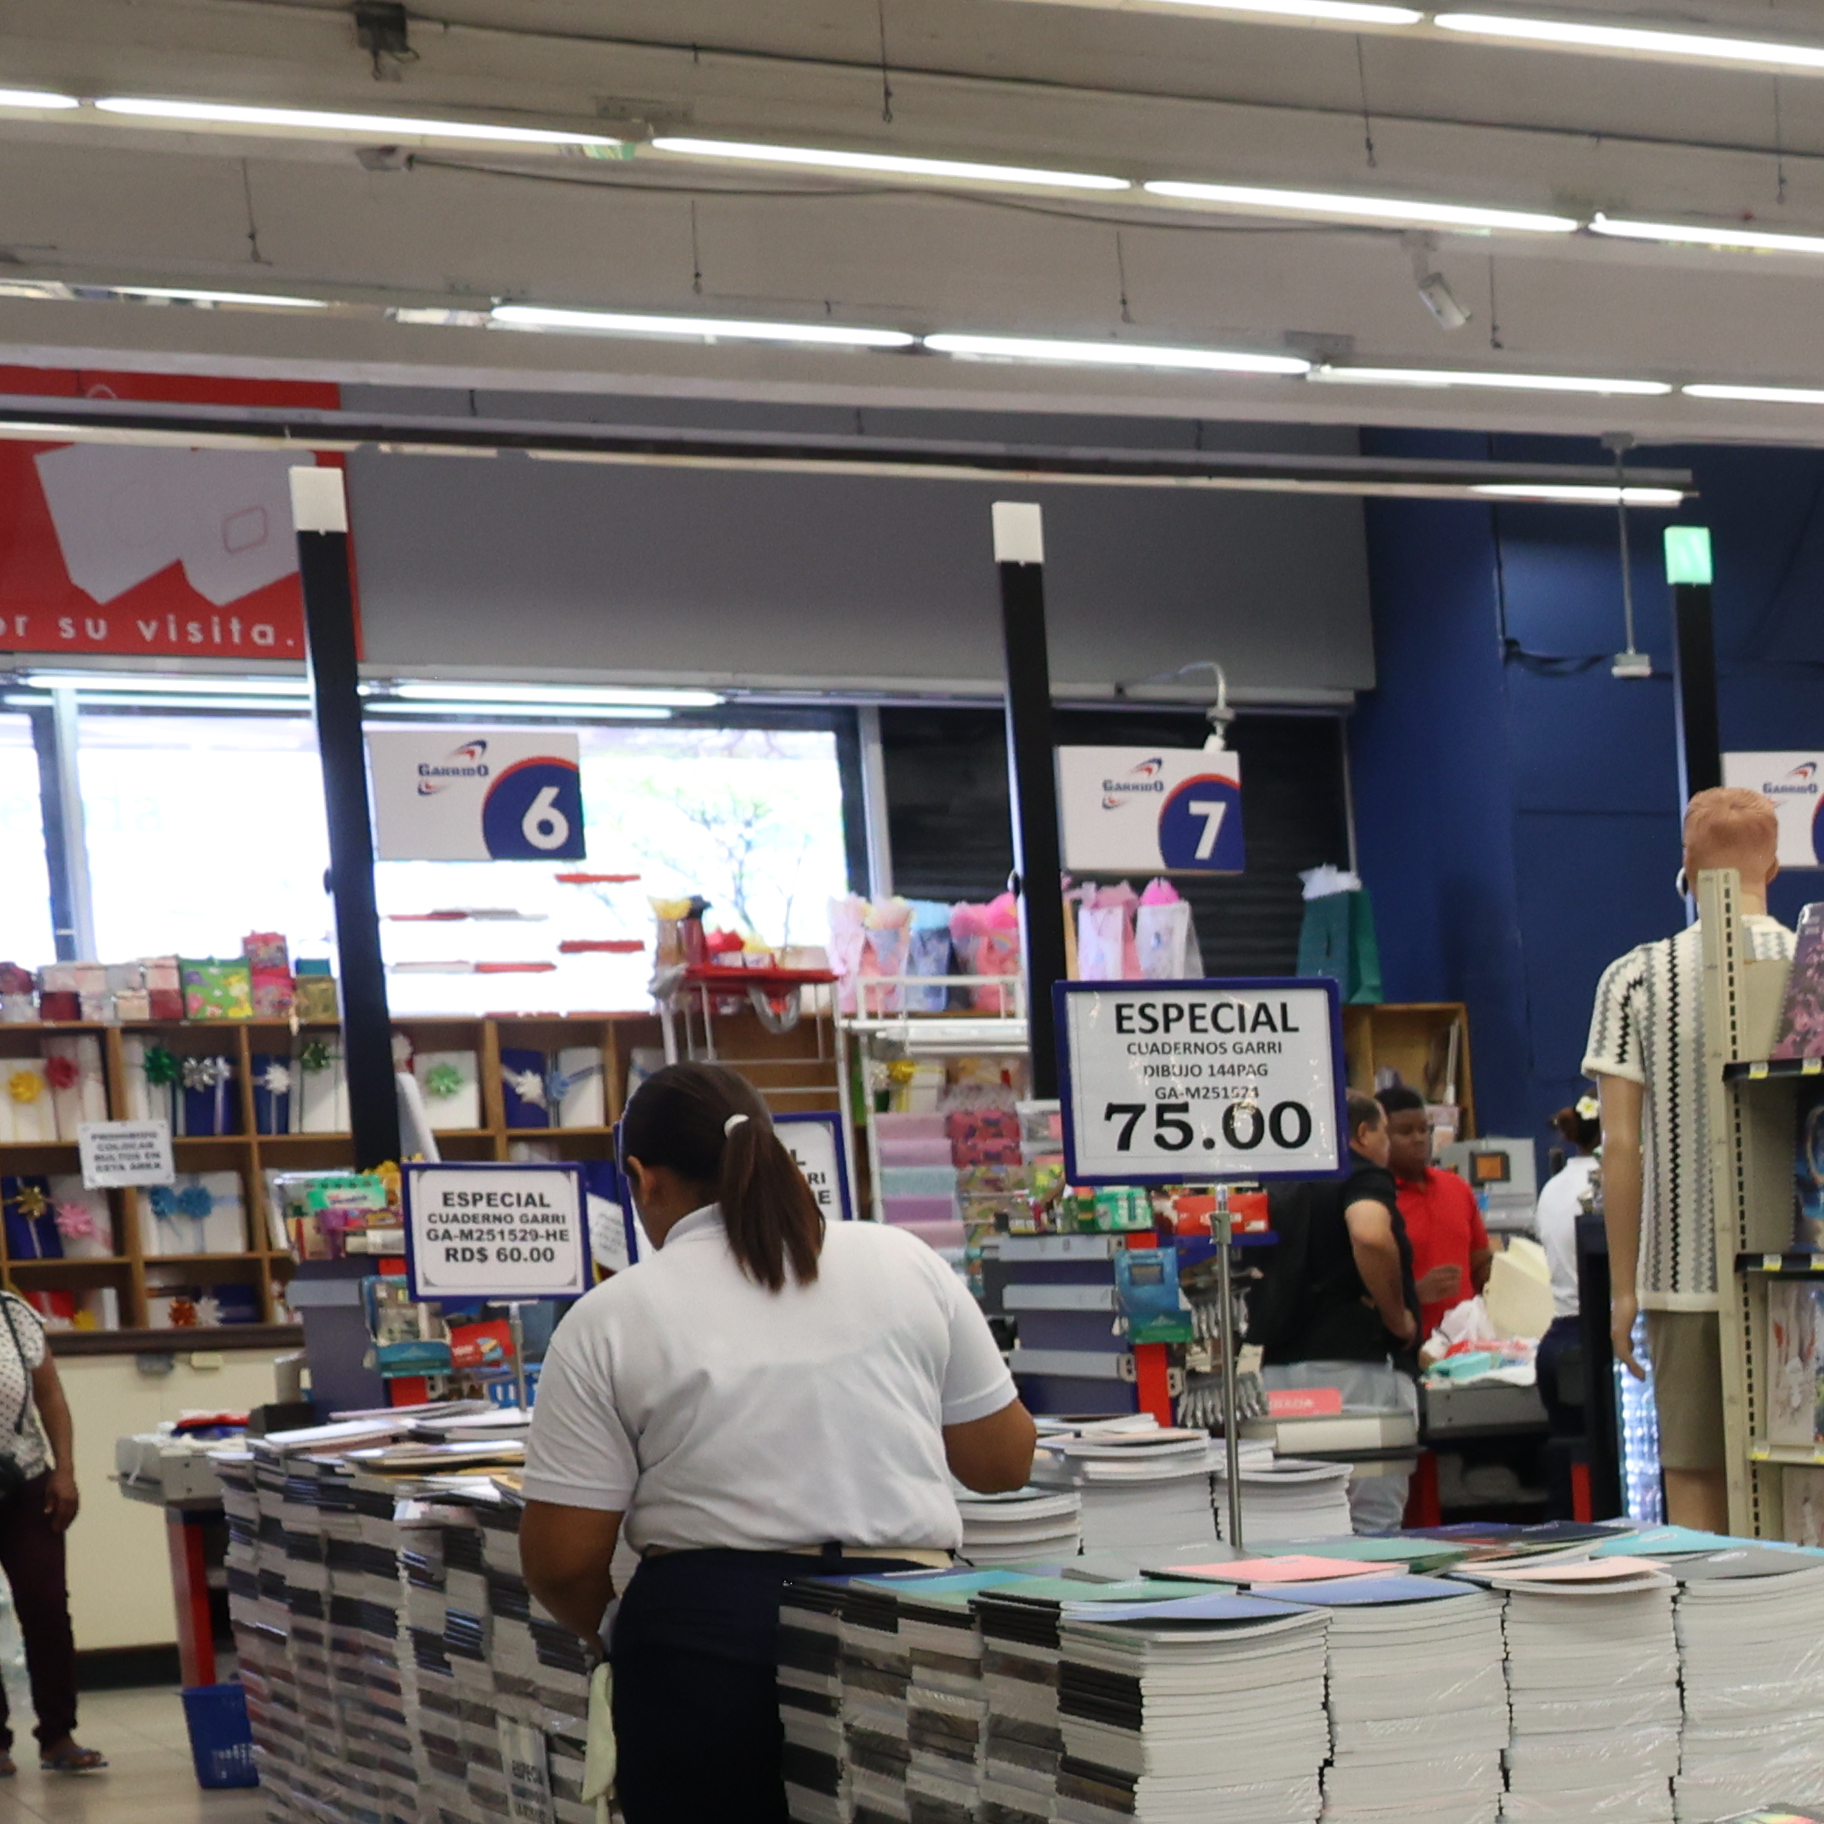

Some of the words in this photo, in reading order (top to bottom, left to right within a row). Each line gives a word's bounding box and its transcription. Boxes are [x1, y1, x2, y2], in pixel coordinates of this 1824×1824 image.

[58, 616, 108, 640] su
[136, 613, 296, 647] visita.
[1102, 780, 1164, 792] GARRIDO
[522, 786, 569, 850] 6
[1188, 801, 1227, 860] 7
[1115, 1002, 1299, 1034] ESPECIAL
[1127, 1042, 1227, 1055] CUADERNOS
[1232, 1041, 1282, 1054] GARRI
[1144, 1064, 1203, 1077] DIBUJO
[1208, 1063, 1268, 1077] 144PAG
[1104, 1100, 1312, 1151] 75.00
[442, 1191, 552, 1209] ESPECIAL
[427, 1213, 514, 1225] CUADERNO
[519, 1213, 567, 1225] GARRI
[426, 1229, 570, 1242] GA-M251529-HE
[444, 1247, 489, 1264] RD$
[496, 1247, 556, 1263] 60.00
